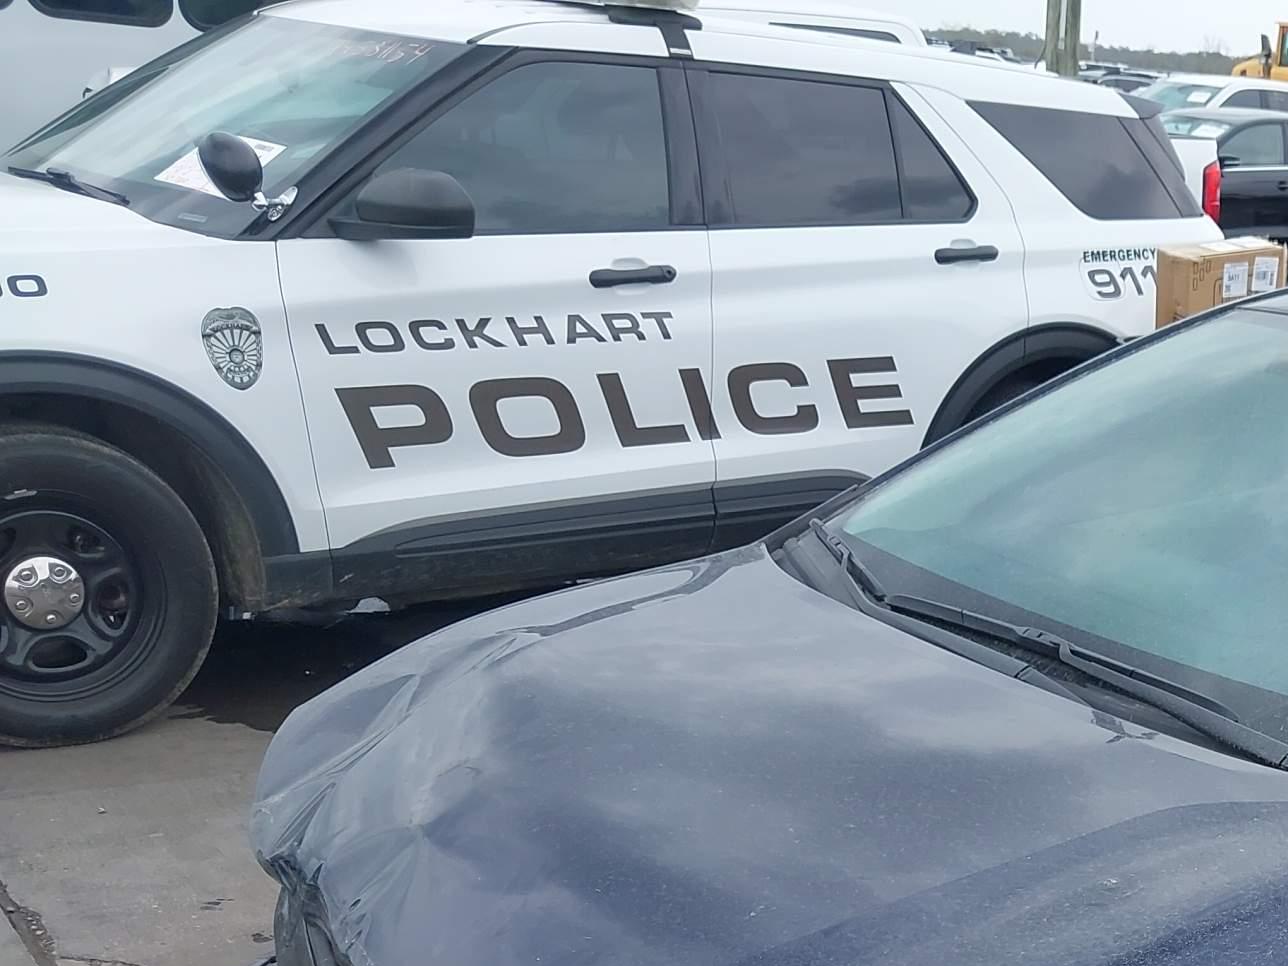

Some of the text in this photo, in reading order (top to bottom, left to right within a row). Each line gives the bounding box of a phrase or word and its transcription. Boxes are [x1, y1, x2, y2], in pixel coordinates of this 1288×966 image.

[1083, 247, 1156, 263] EMERGENCY
[0, 274, 49, 298] 0
[1086, 265, 1157, 298] 911
[314, 311, 674, 356] LOCKHART
[333, 355, 915, 470] POLICE
